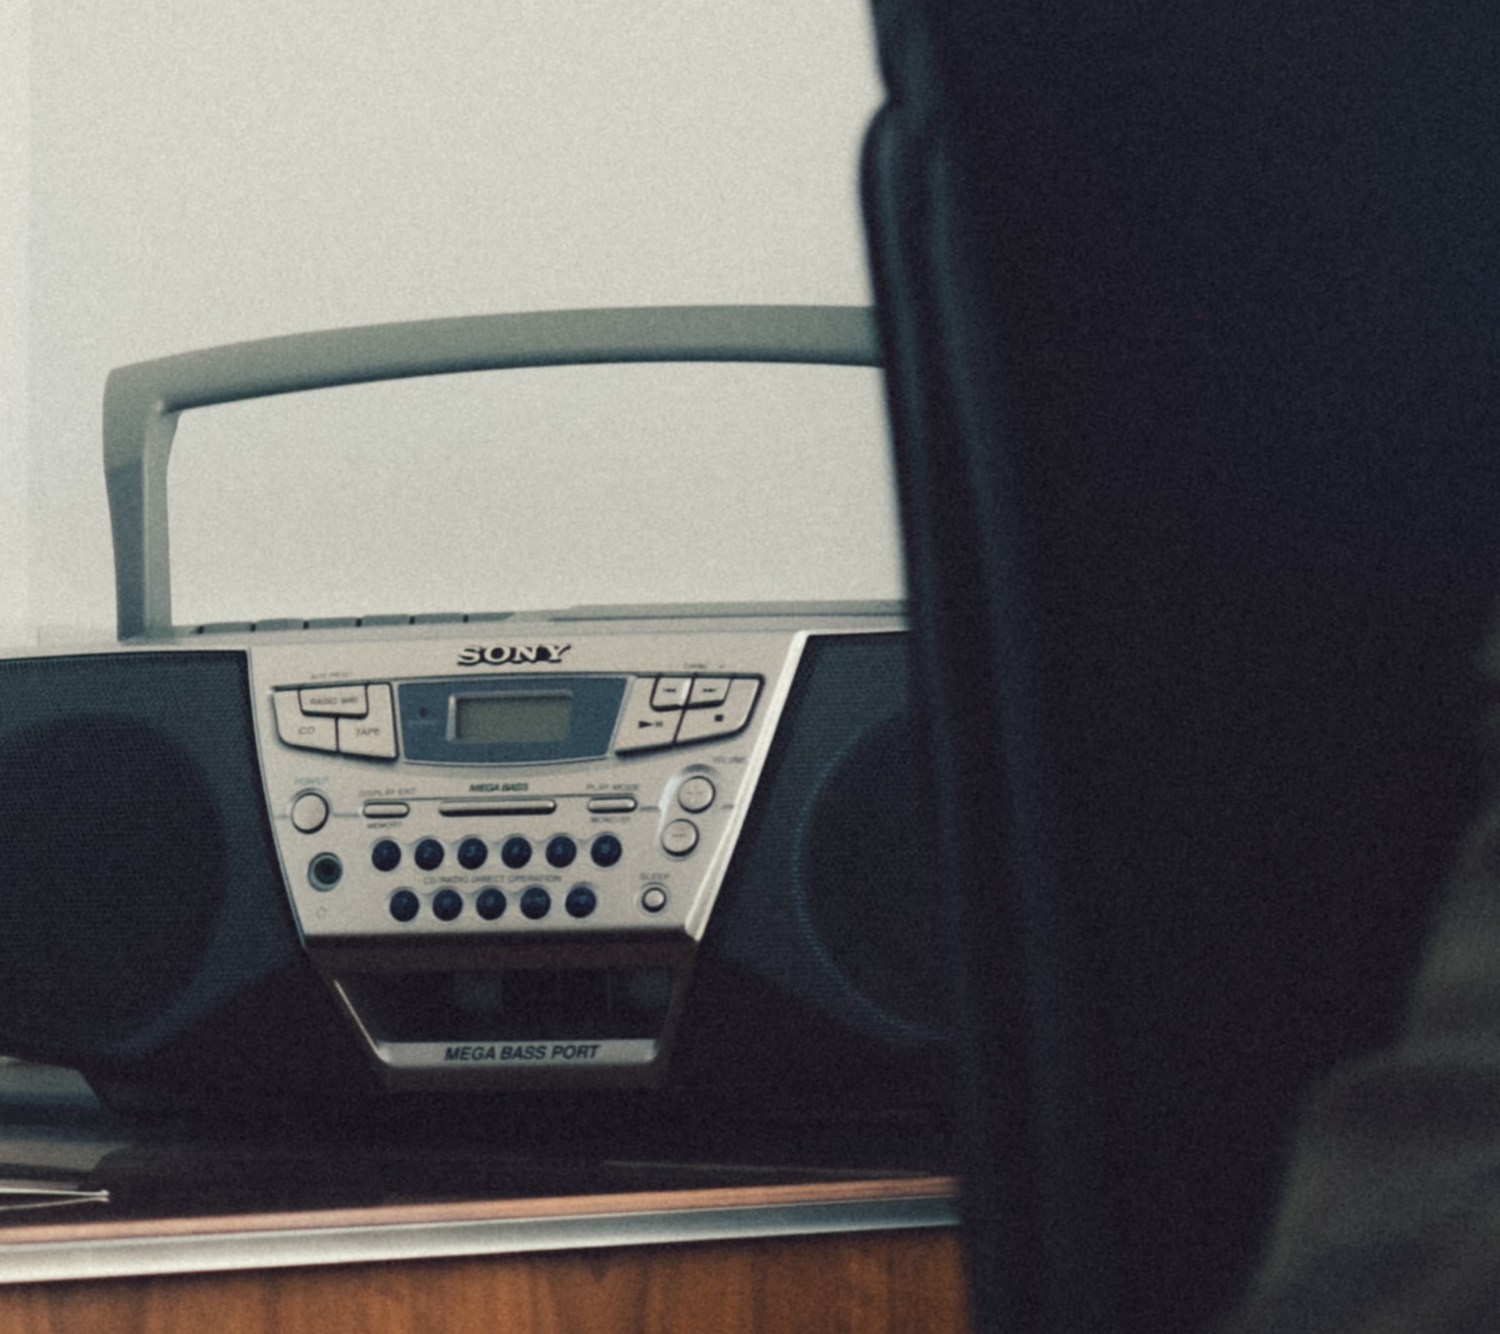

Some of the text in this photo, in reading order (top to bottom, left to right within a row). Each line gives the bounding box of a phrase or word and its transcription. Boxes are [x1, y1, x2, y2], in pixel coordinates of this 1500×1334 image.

[457, 644, 572, 667] SONY
[309, 696, 338, 706] RADIO
[298, 725, 316, 736] CD
[355, 726, 380, 737] TAPE
[468, 782, 529, 793] MEGA BASS
[586, 782, 640, 792] PLAY MODE
[358, 788, 396, 798] DISPLAY
[366, 820, 402, 830] MEMORY
[471, 875, 505, 884] DIRECT
[507, 874, 562, 884] OPERATION
[640, 871, 670, 881] SLEEP
[444, 1044, 601, 1061] MEGA BASS PORT
